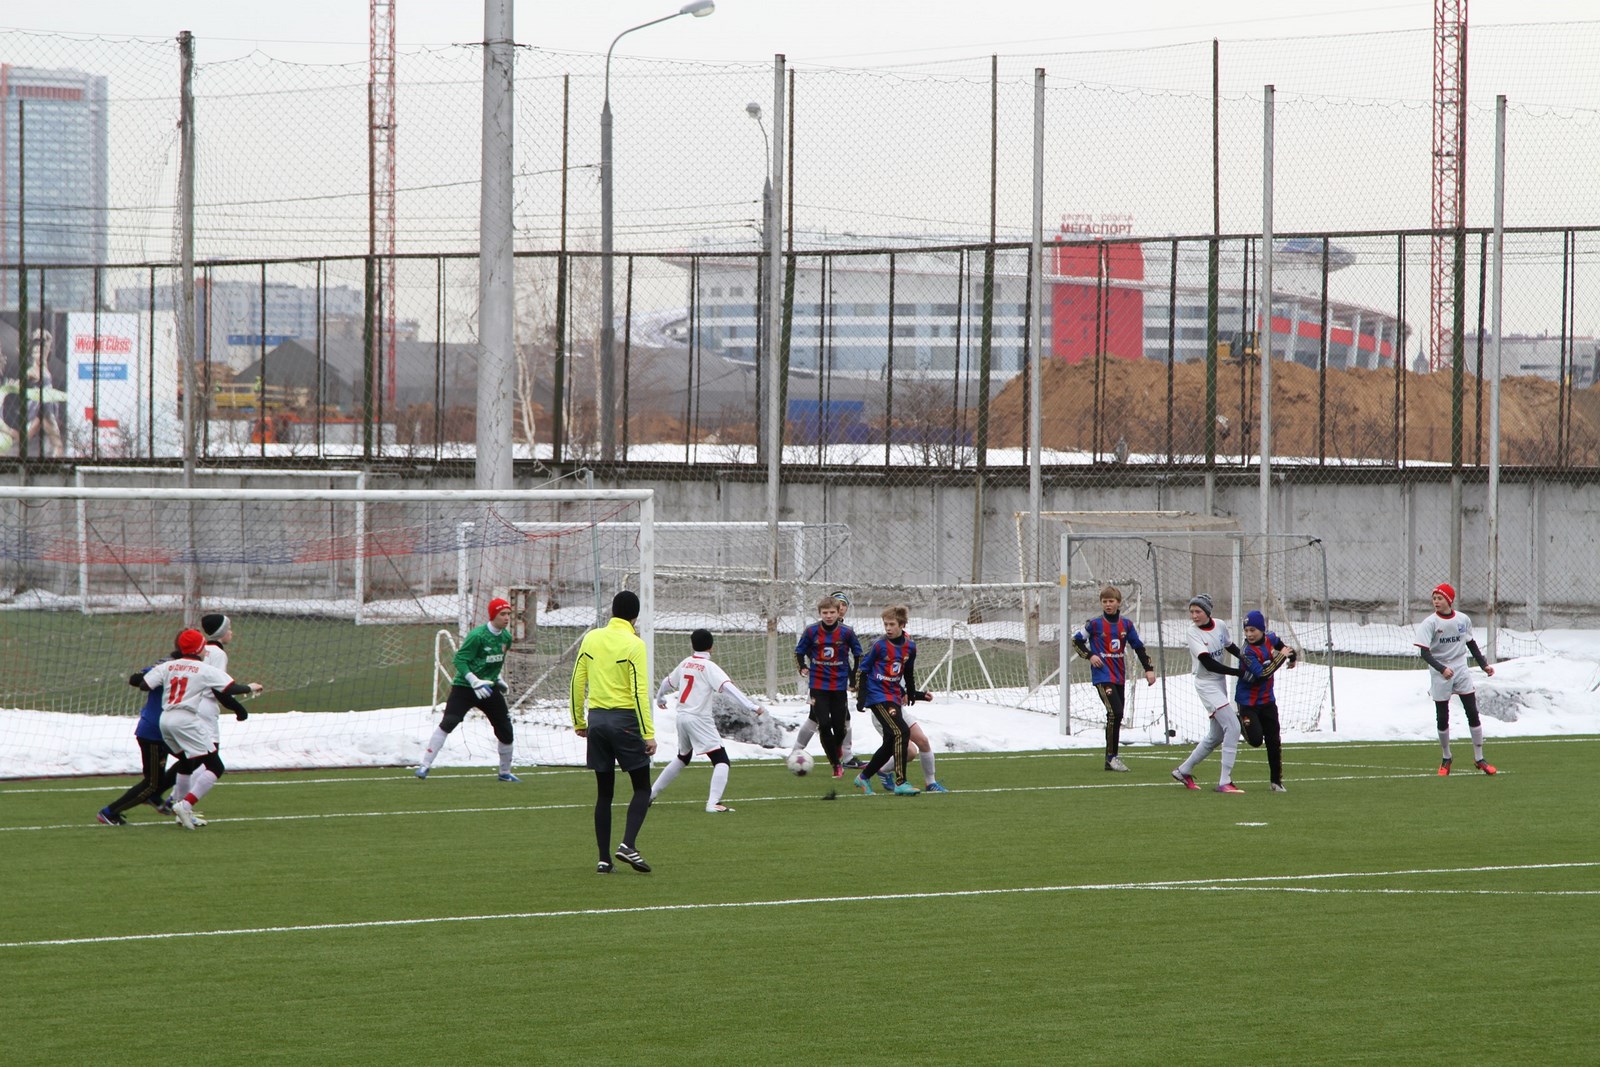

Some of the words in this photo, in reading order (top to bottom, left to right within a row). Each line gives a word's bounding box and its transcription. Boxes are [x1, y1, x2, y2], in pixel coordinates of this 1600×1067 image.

[1060, 223, 1133, 235] МЕГАСПОРТ
[75, 335, 104, 353] Word
[105, 336, 131, 354] Class
[1439, 635, 1461, 645] МЖБК
[167, 676, 189, 704] 11
[680, 674, 695, 704] 7
